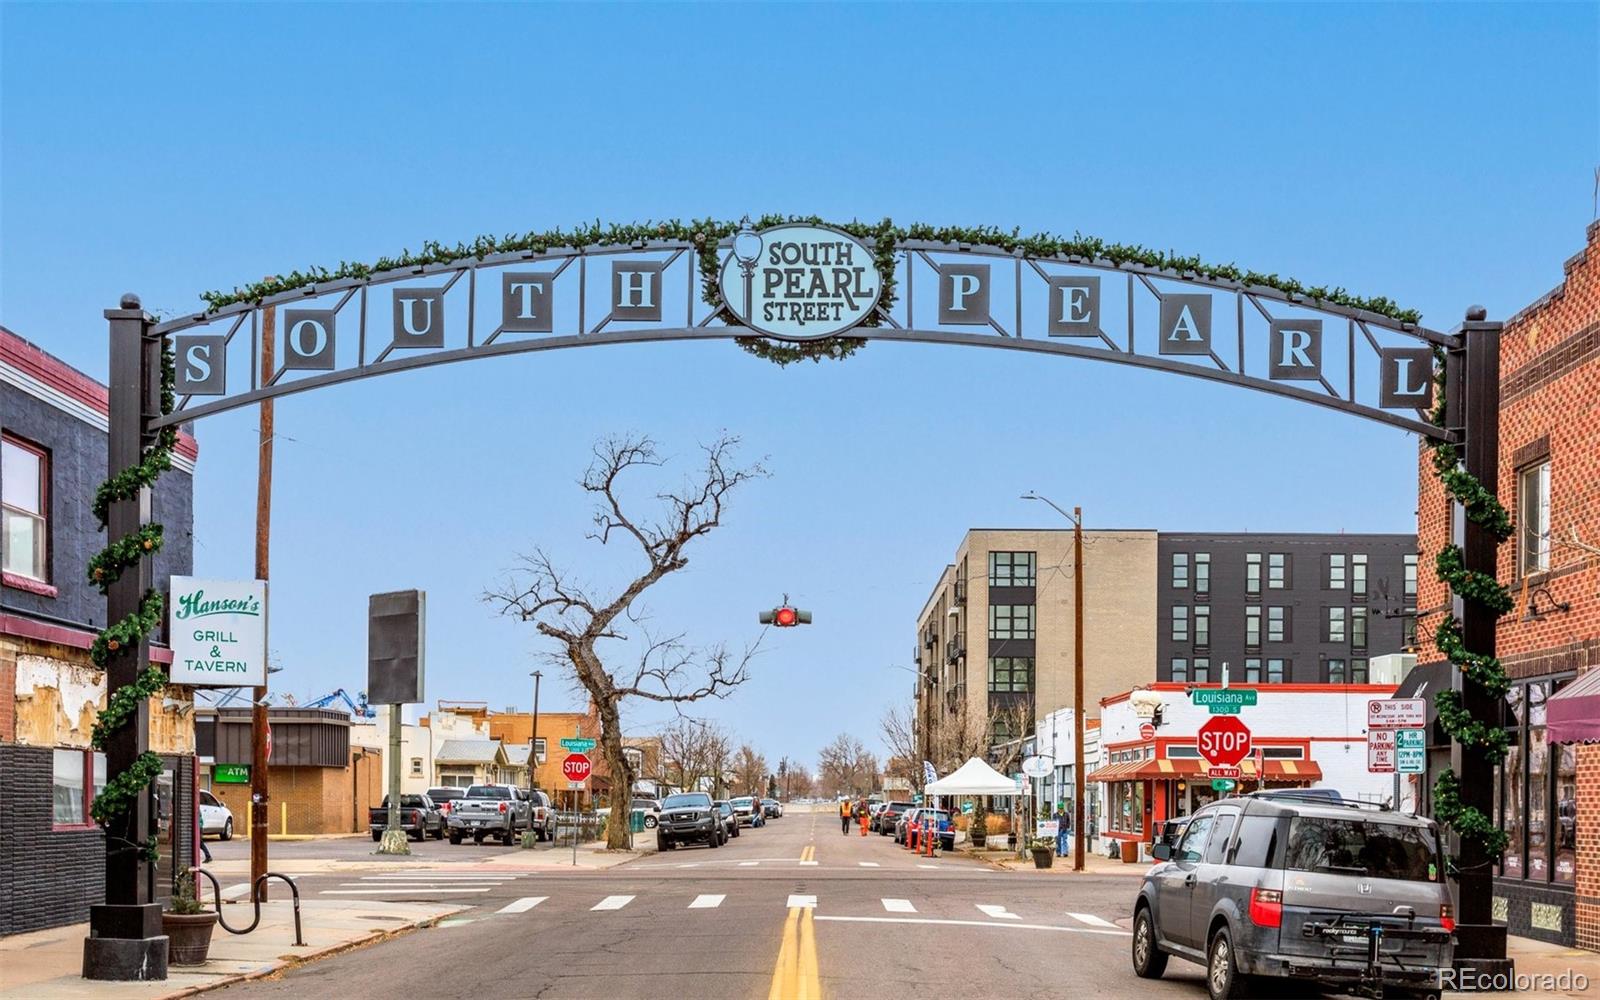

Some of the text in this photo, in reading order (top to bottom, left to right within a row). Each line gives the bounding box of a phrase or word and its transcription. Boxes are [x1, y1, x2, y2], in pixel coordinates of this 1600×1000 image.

[769, 241, 853, 266] SOUTH
[763, 267, 873, 310] PEARL
[763, 301, 844, 325] STREET
[176, 590, 259, 619] Hanson's
[193, 630, 238, 643] GRILL
[209, 645, 221, 658] &
[184, 660, 247, 673] TAVERN
[1195, 692, 1243, 704] Louisiana
[1201, 731, 1248, 751] STOP
[1376, 732, 1388, 741] NO
[1397, 734, 1403, 746] 2
[227, 768, 248, 776] ATM
[564, 762, 590, 773] STOP
